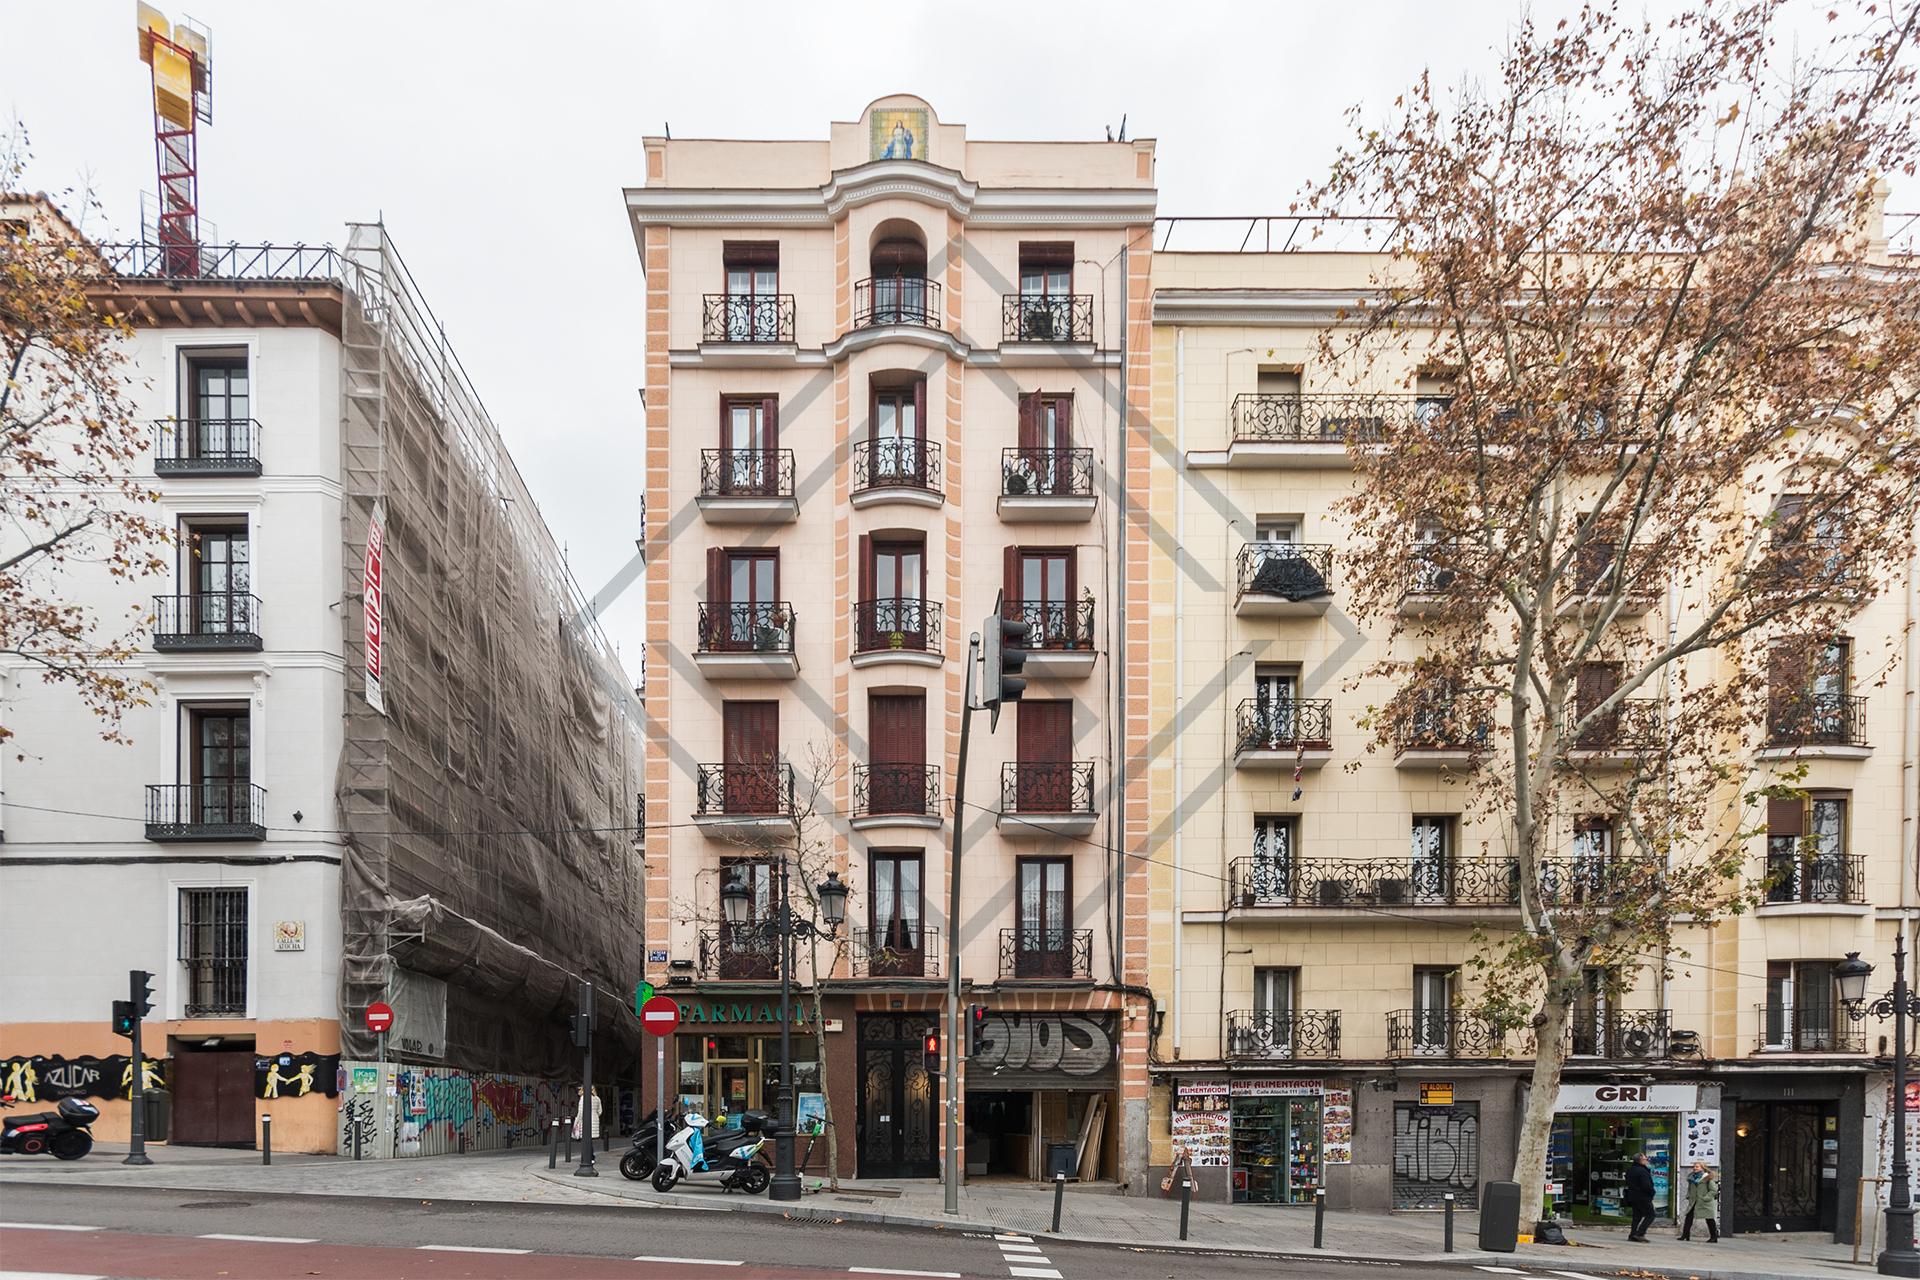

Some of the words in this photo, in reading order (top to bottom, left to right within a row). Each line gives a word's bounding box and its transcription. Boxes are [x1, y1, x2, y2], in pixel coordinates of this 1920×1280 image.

[679, 1003, 824, 1022] FARMACIA
[44, 1065, 100, 1088] AZUCAR
[1232, 1081, 1252, 1089] ALIF
[1429, 1083, 1453, 1091] ALQUILA
[1595, 1086, 1648, 1102] GRI
